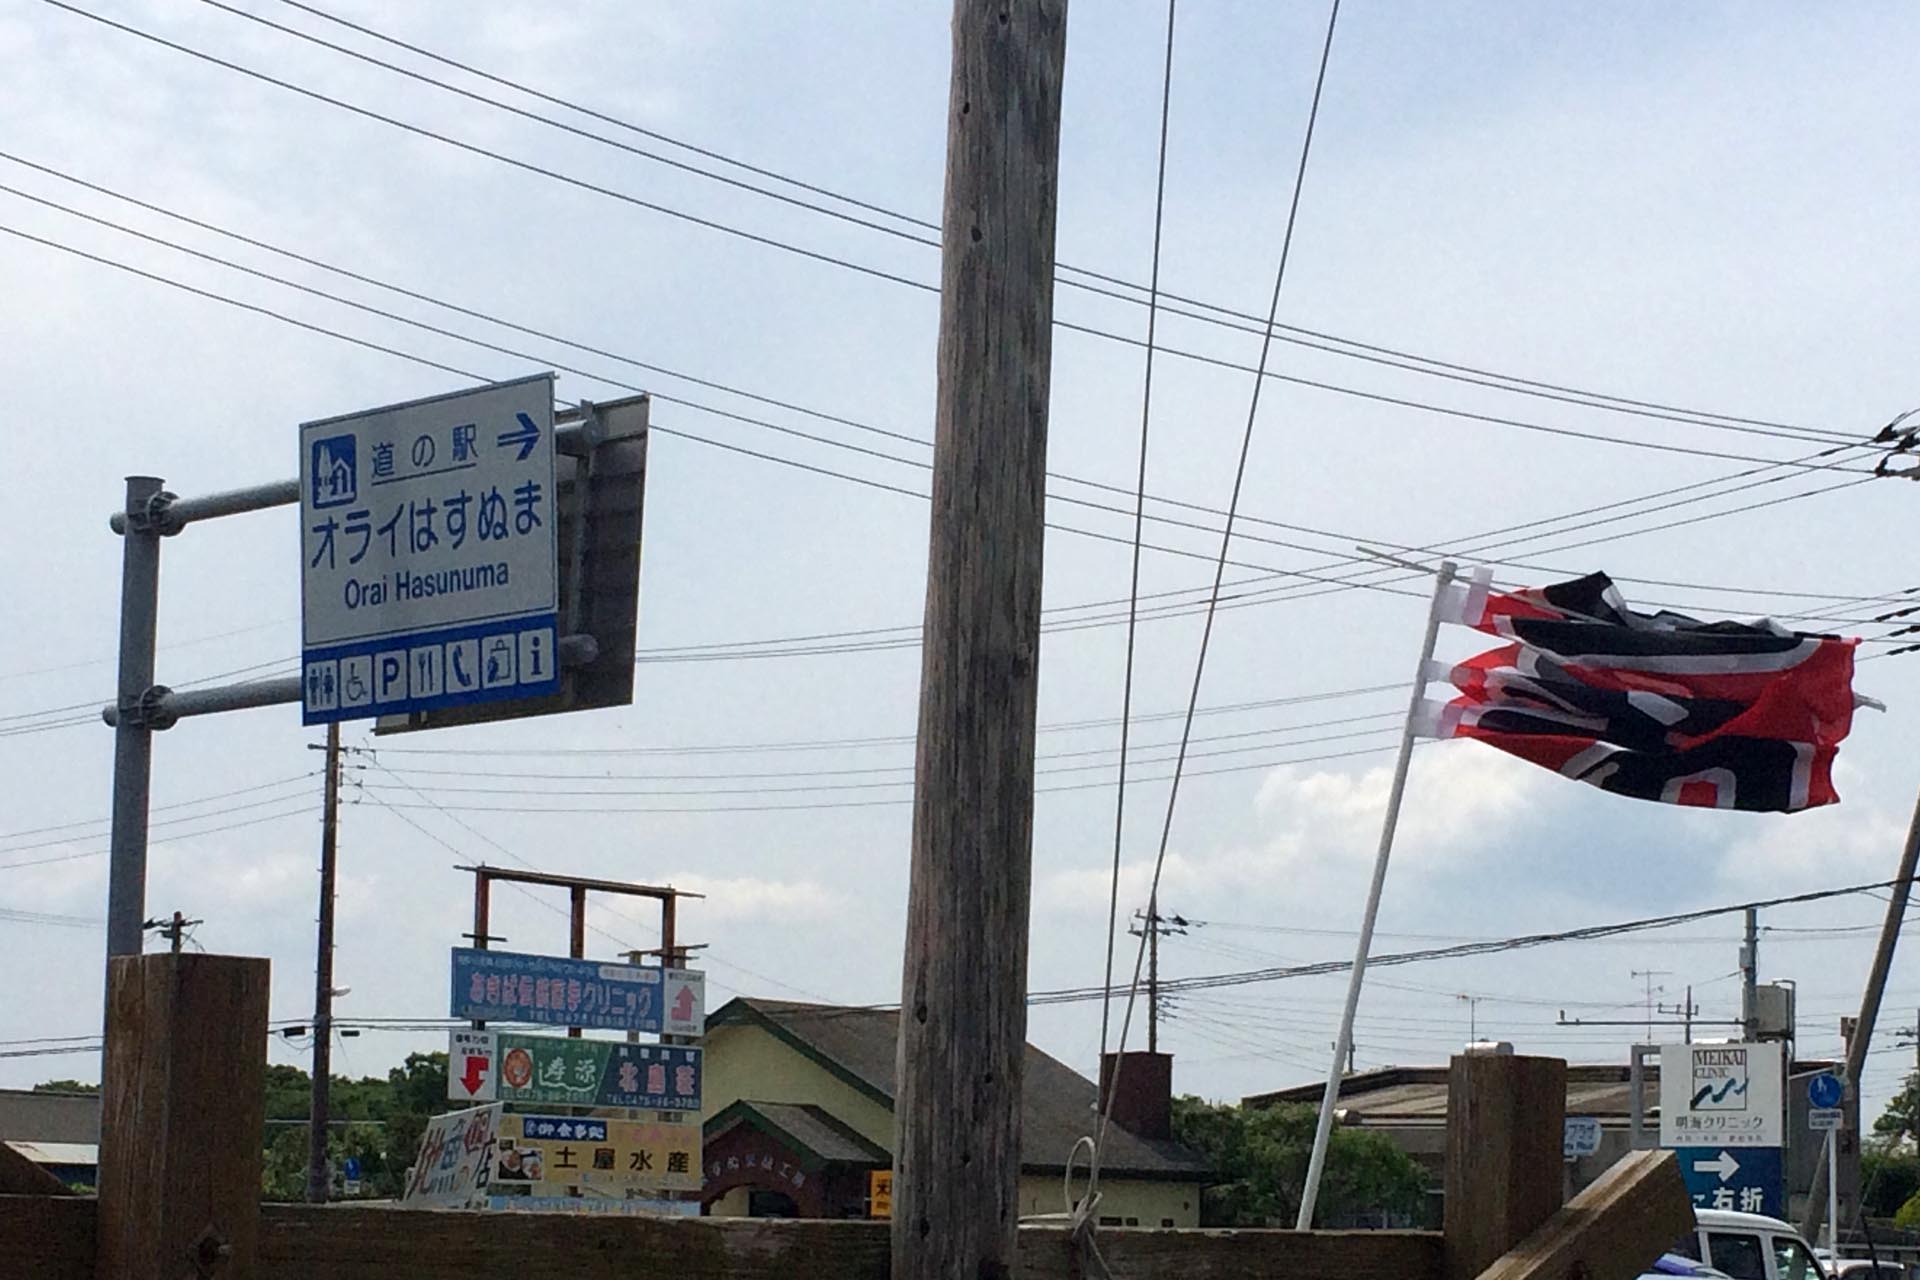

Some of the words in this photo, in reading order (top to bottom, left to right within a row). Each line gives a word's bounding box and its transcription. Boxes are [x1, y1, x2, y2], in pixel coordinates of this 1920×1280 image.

[370, 423, 478, 478] 道の駅
[311, 479, 543, 570] オライはすぬま
[344, 576, 388, 610] Orai
[396, 562, 509, 601] Hasunuma
[1694, 1050, 1745, 1065] MEIKAI
[1694, 1067, 1730, 1079] CLINIC
[553, 1145, 689, 1173] 土屋水産
